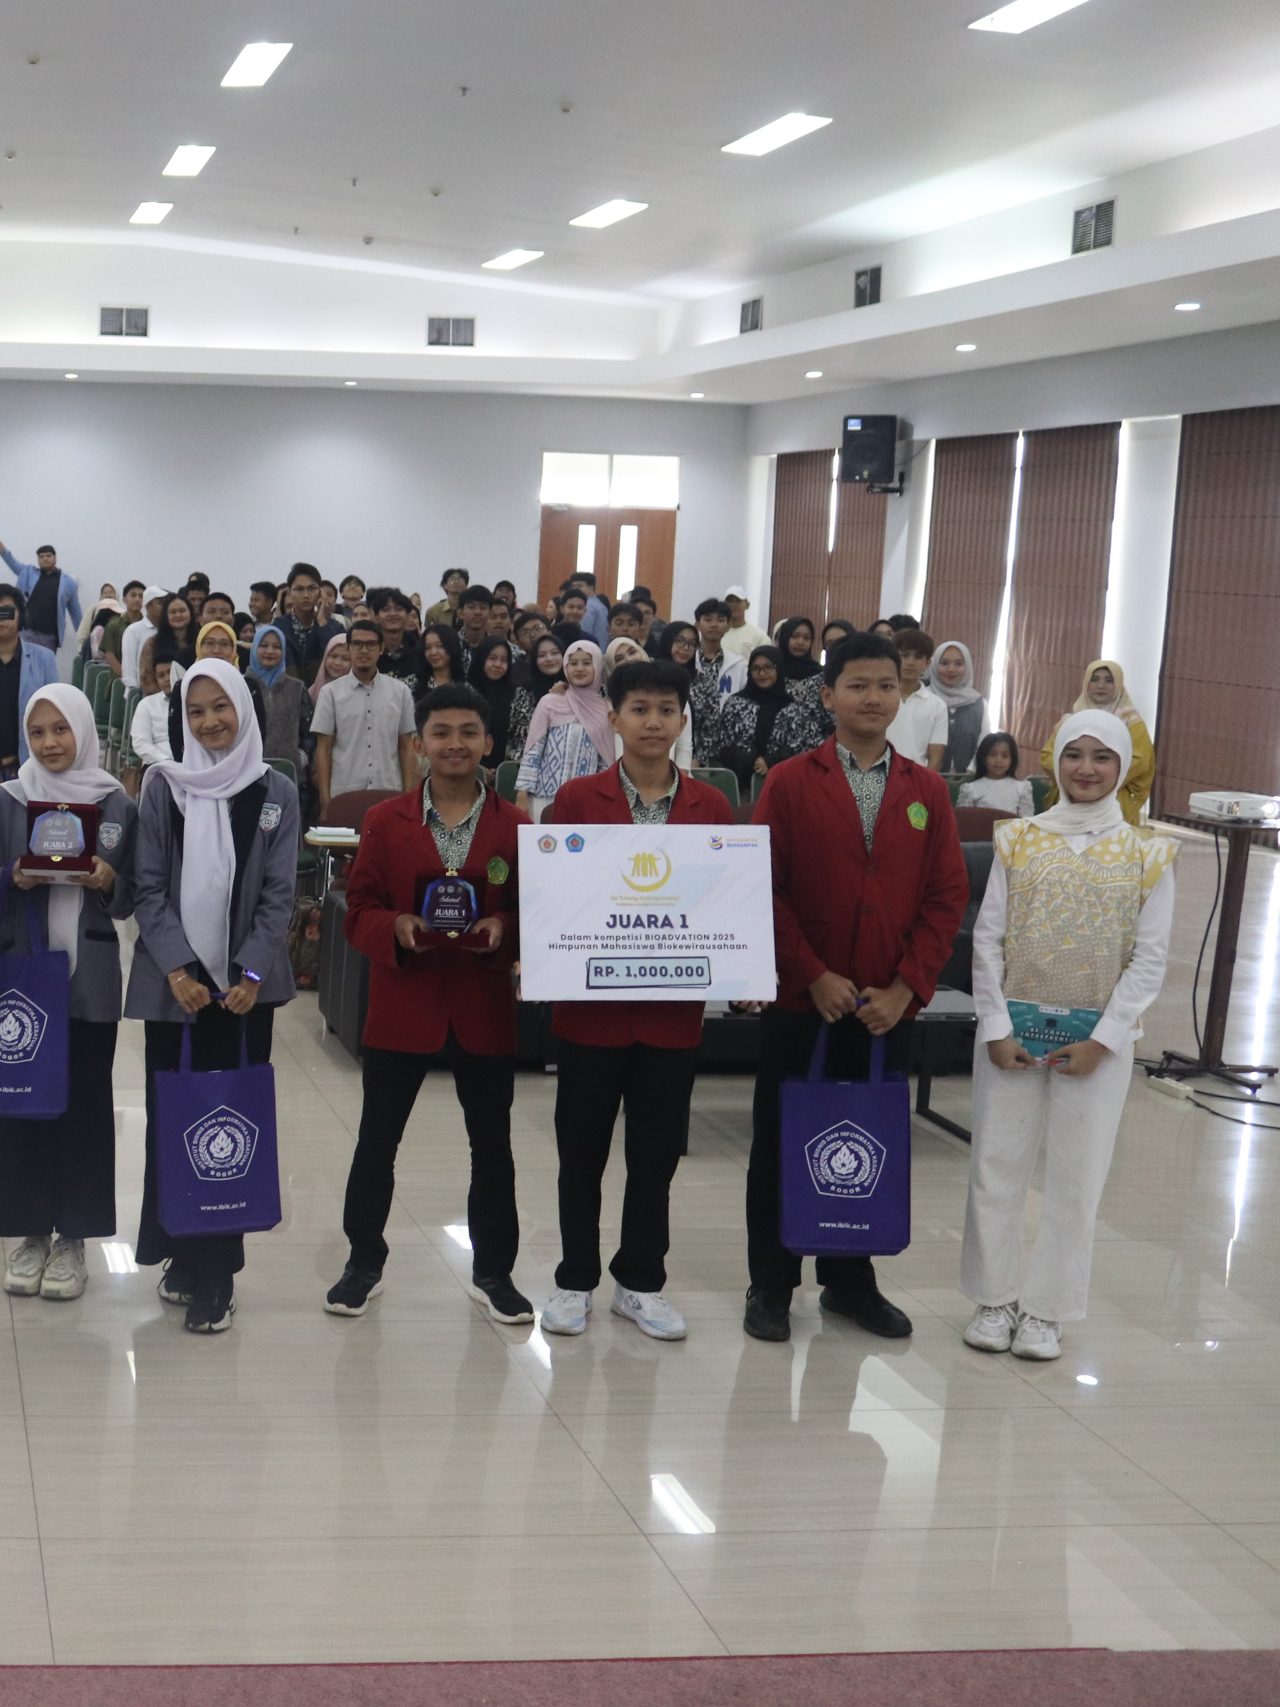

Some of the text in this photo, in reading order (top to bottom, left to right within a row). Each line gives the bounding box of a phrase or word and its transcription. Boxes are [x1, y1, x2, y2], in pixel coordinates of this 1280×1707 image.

[606, 914, 688, 929] JUARA 1
[594, 934, 642, 942] kompetisi
[548, 943, 598, 952] Himpunan
[594, 966, 704, 978] RP. 1,000,000
[818, 1222, 870, 1230] www.ibik.ac.id
